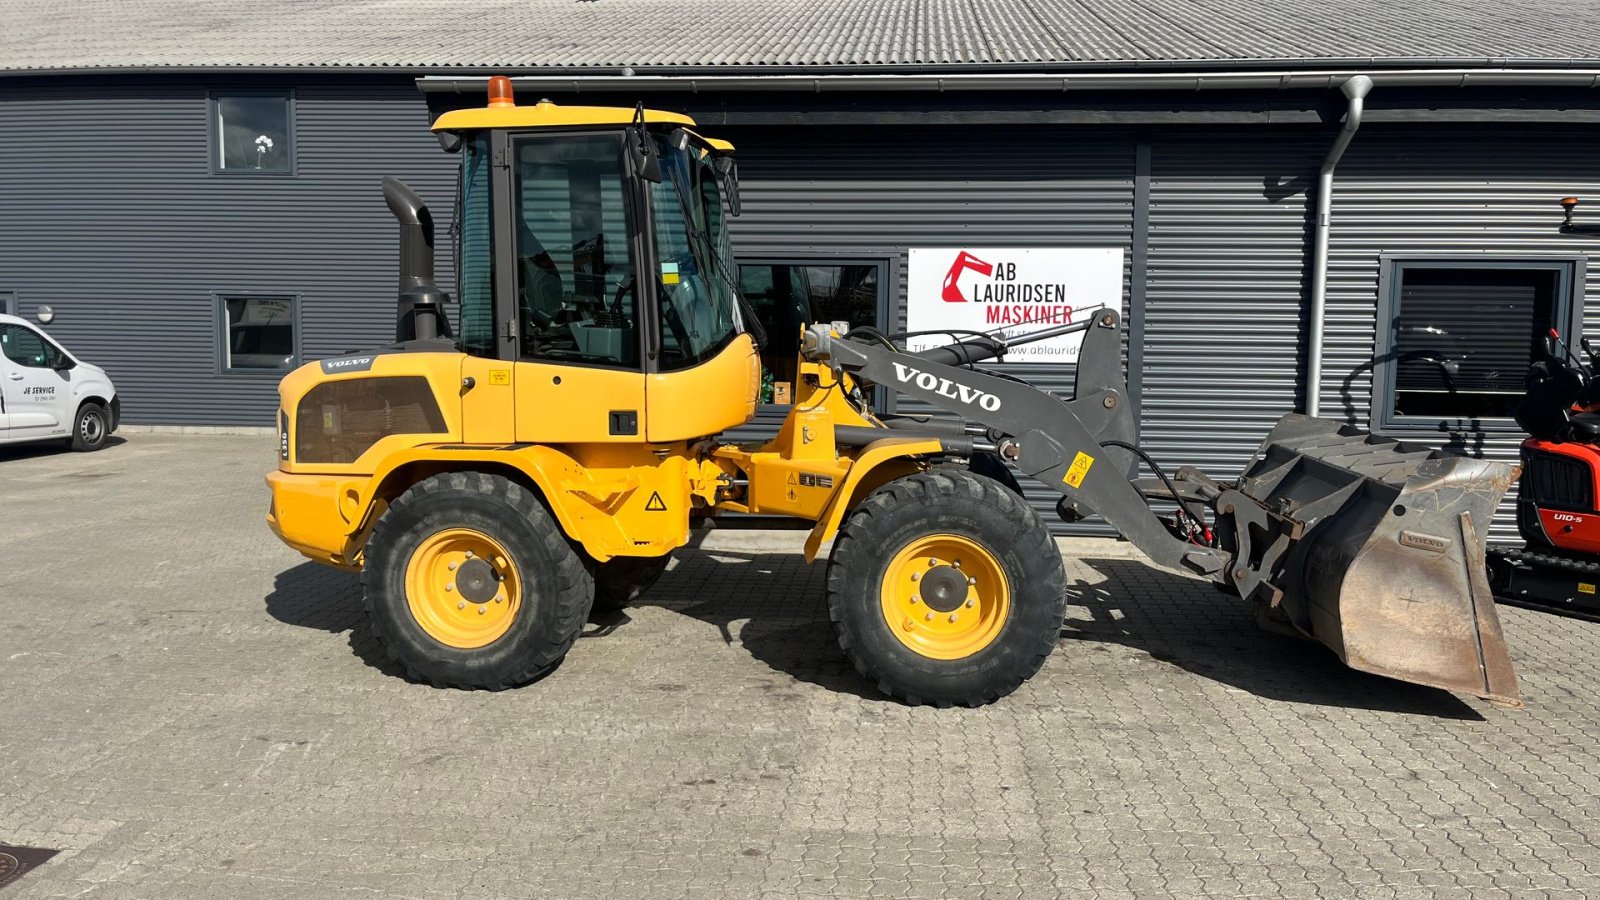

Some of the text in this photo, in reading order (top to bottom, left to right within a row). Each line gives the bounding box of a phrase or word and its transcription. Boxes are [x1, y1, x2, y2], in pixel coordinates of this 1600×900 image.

[995, 262, 1016, 281] AB
[974, 284, 1065, 303] LAURIDSEN
[986, 305, 1073, 324] MASKINER
[327, 358, 370, 369] VOLVO
[32, 386, 55, 394] SERVICE
[892, 362, 1002, 412] VOLVO
[1407, 535, 1444, 548] VOLVO
